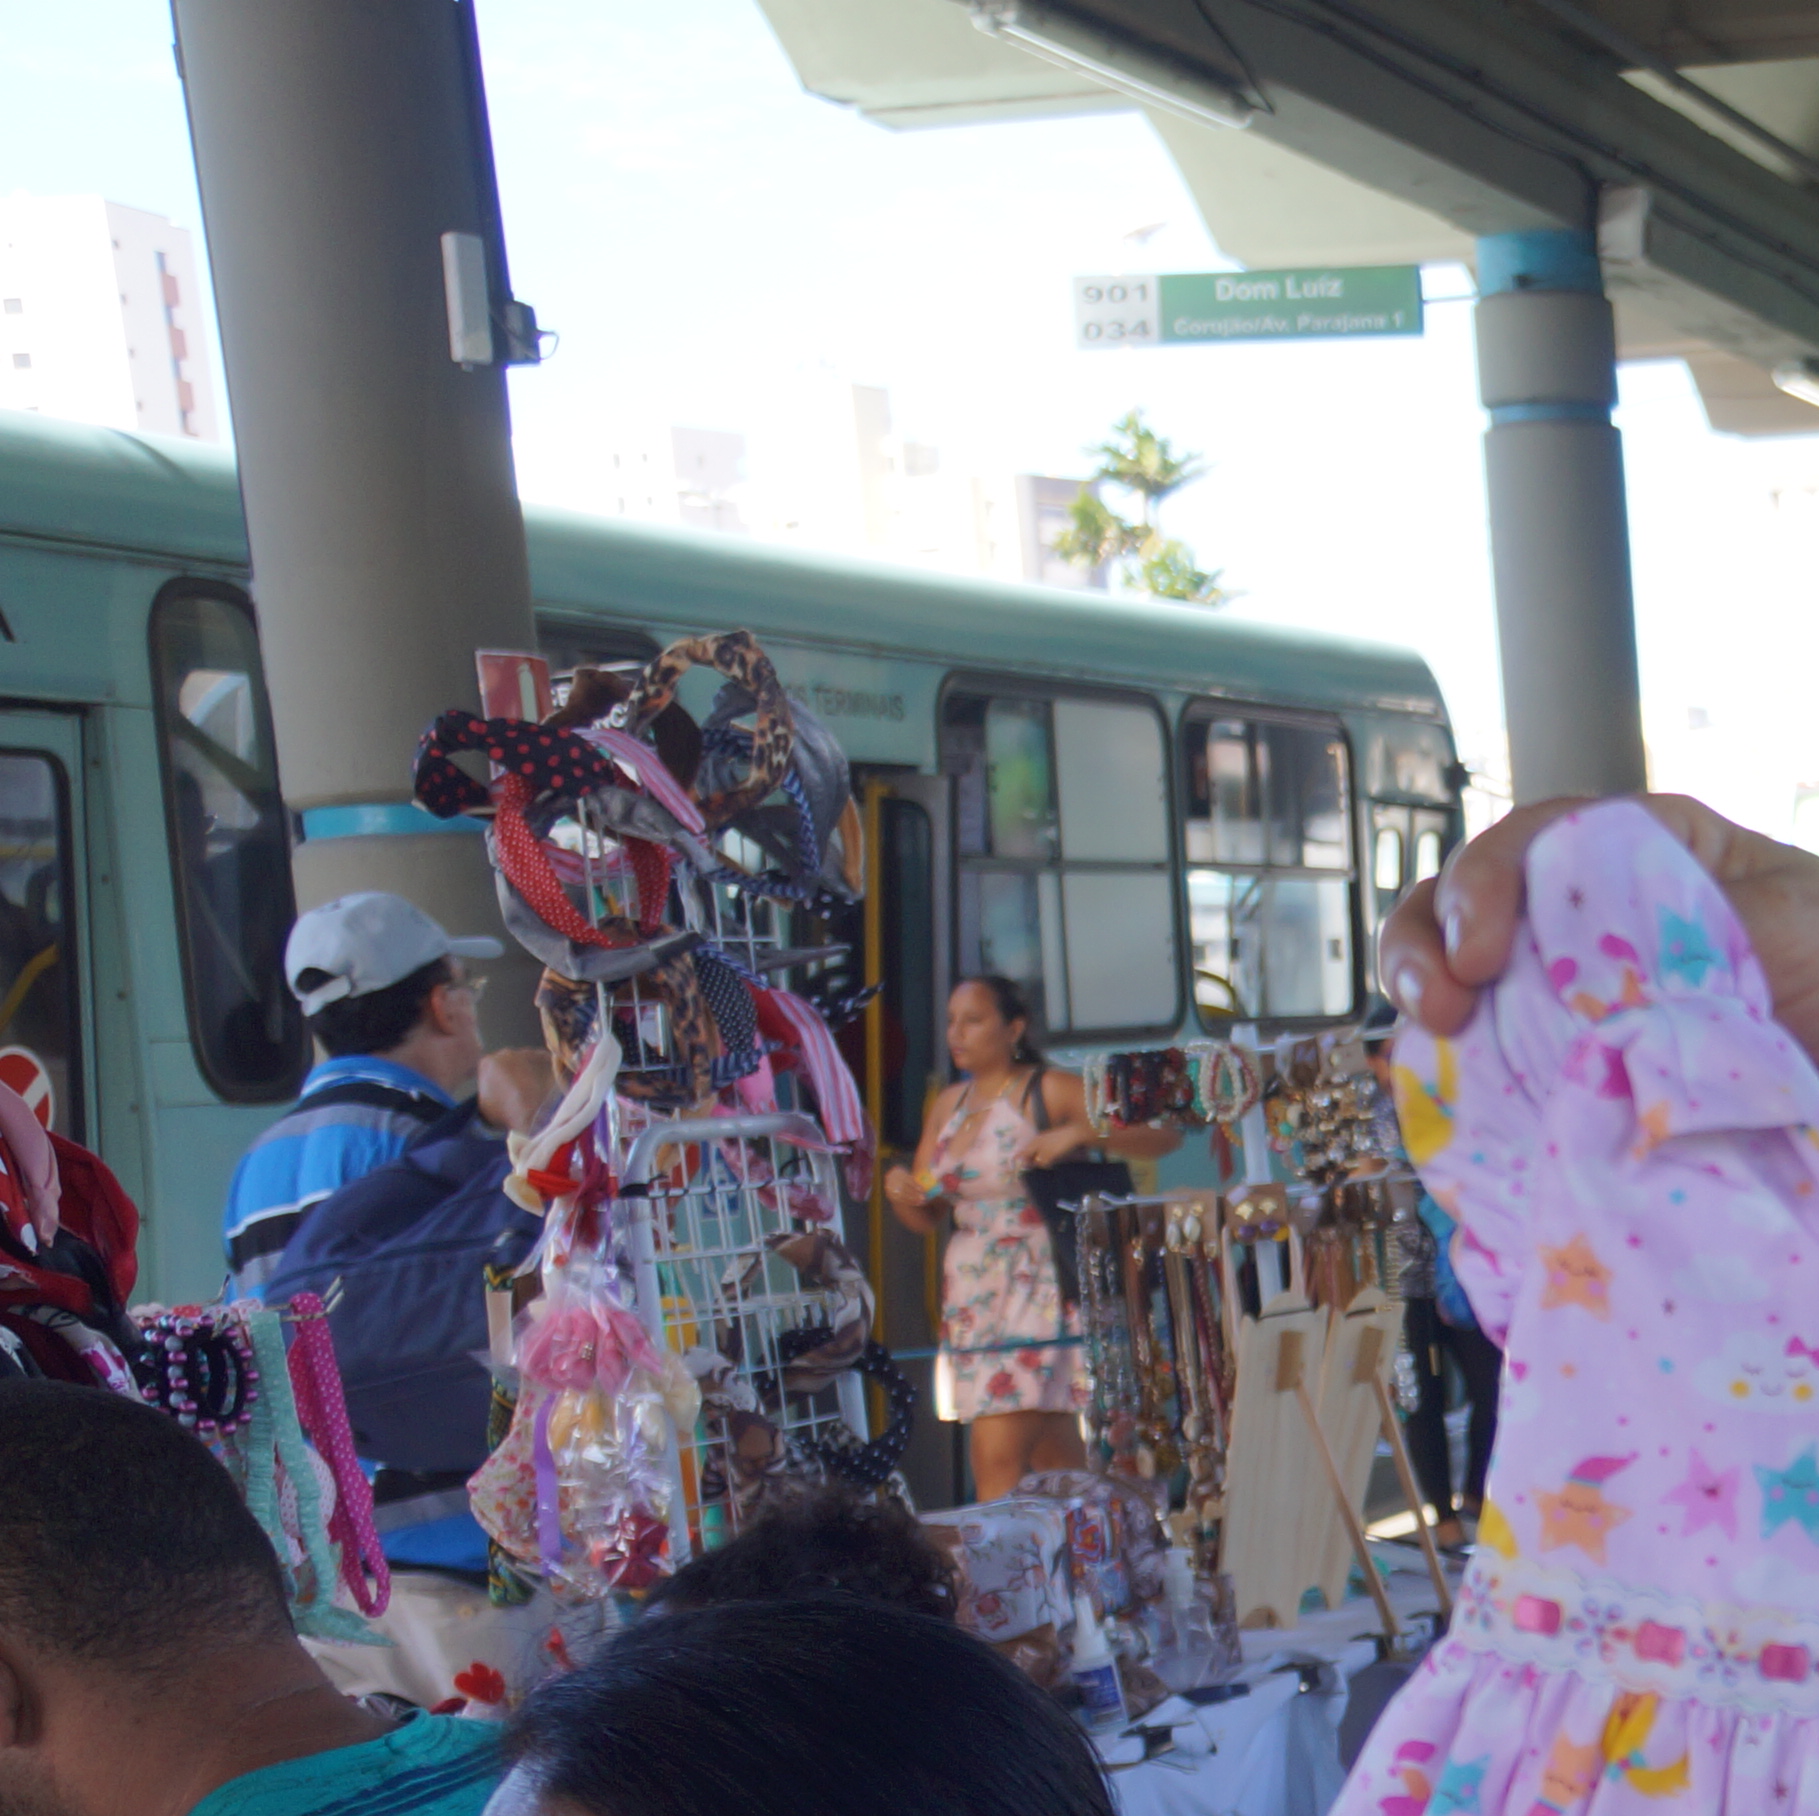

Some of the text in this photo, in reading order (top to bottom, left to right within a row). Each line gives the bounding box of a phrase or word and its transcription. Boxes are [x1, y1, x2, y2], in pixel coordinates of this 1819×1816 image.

[1083, 283, 1147, 303] 901
[1215, 278, 1278, 301] Dom
[1084, 320, 1149, 340] 034
